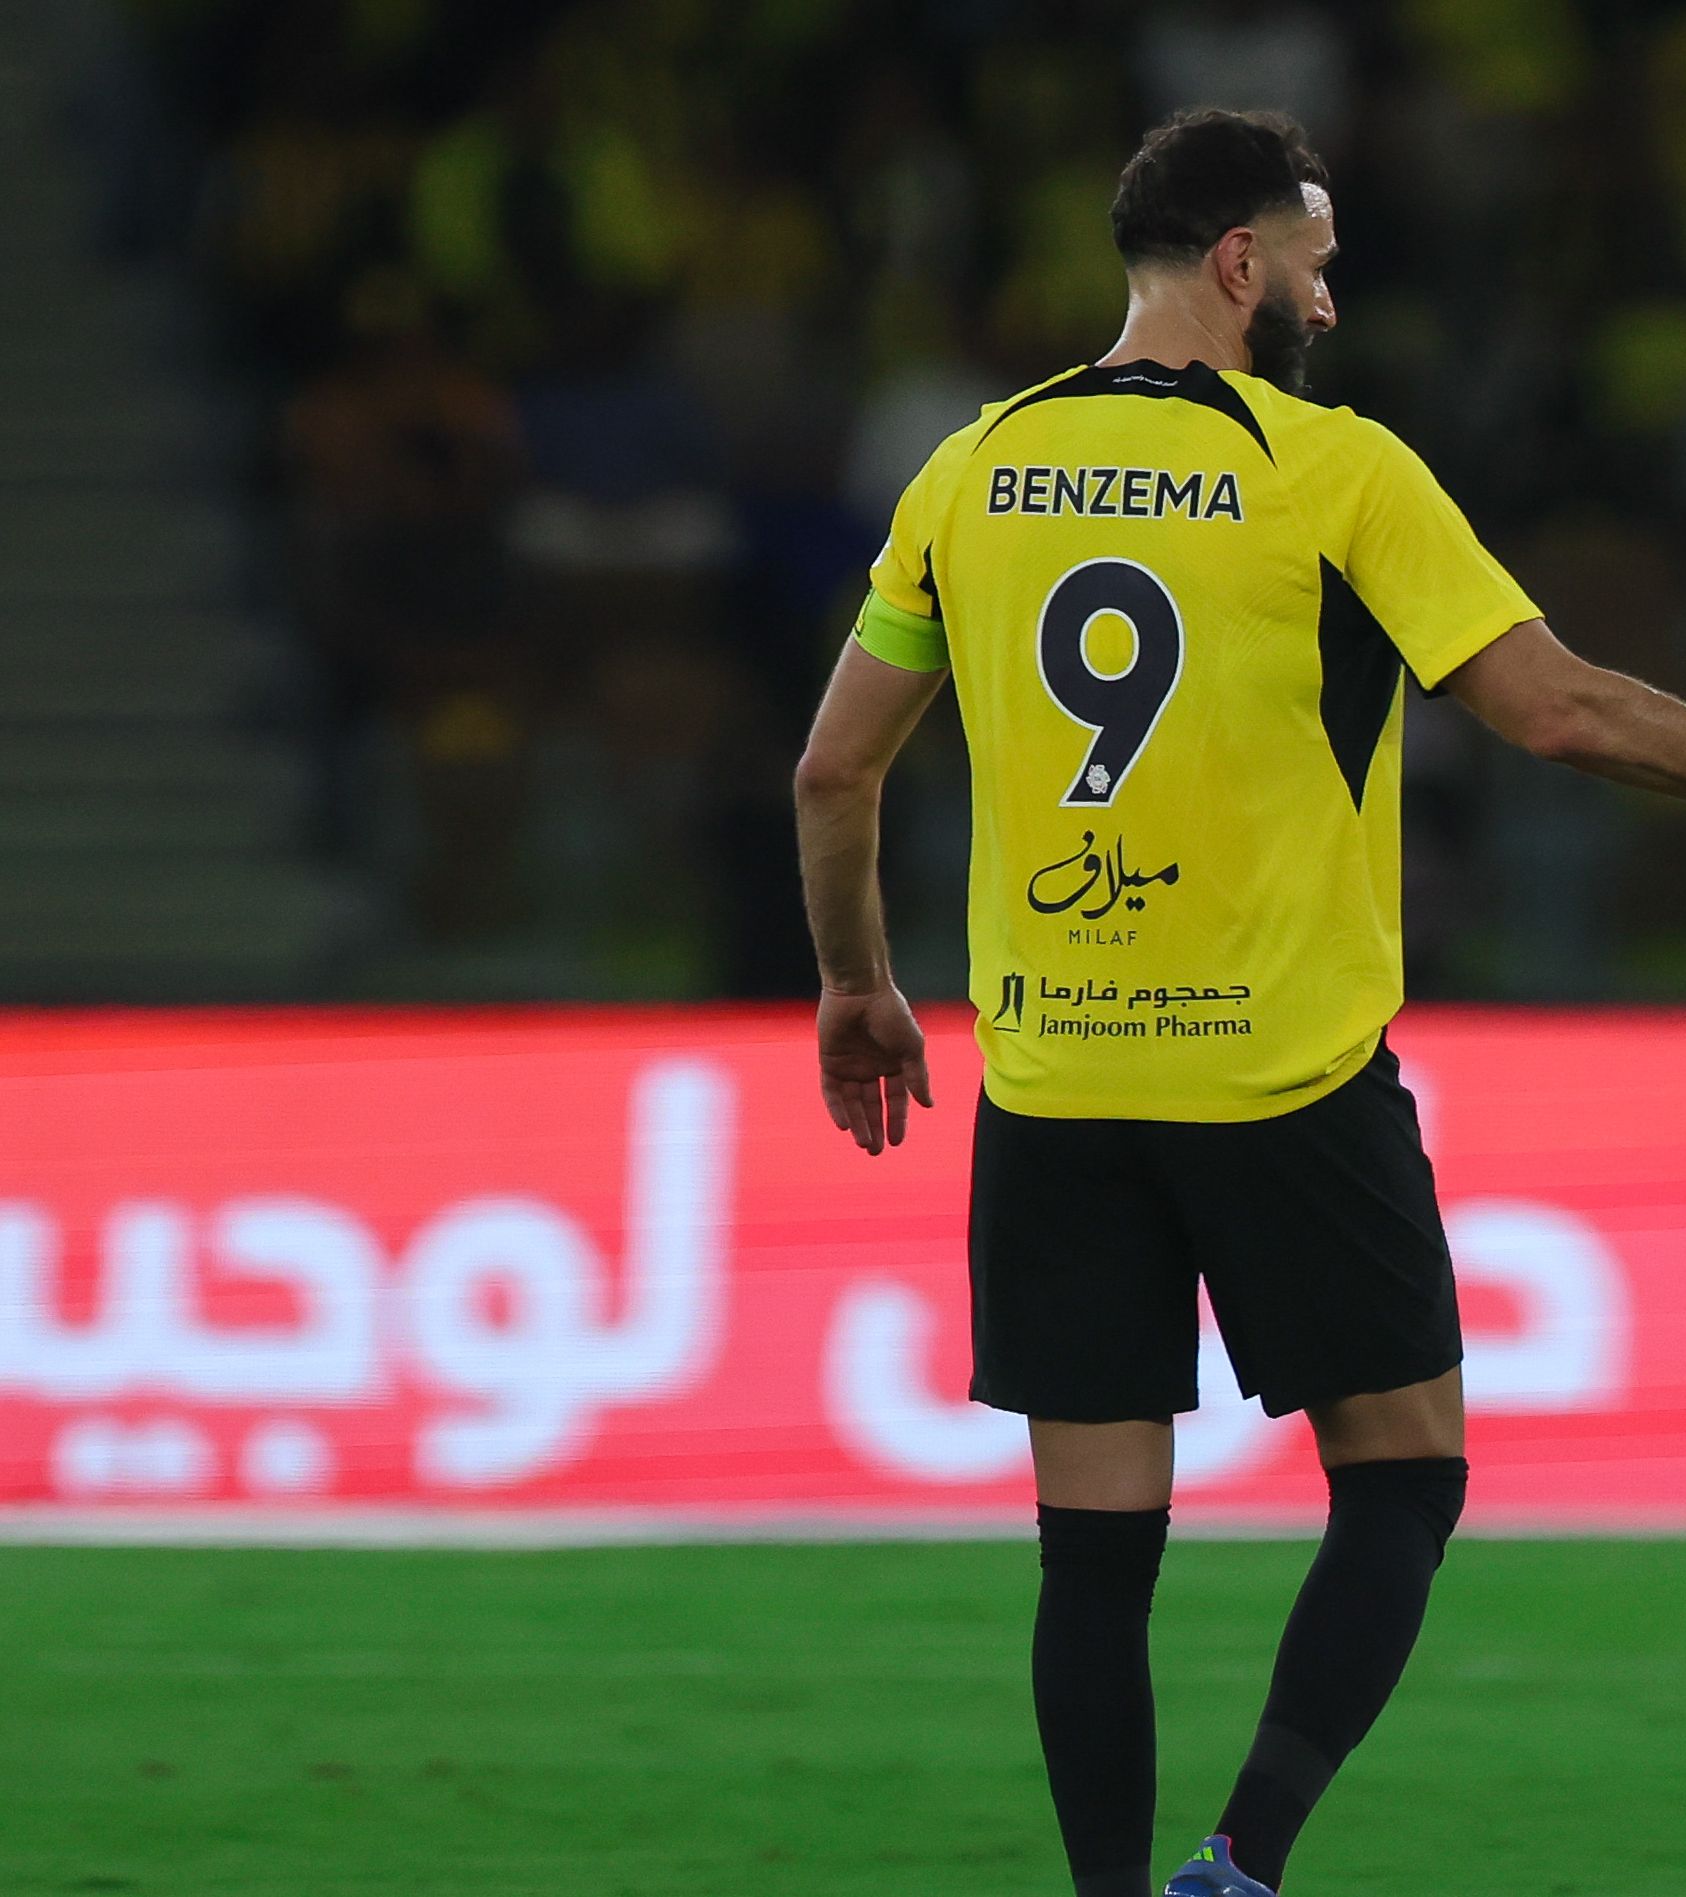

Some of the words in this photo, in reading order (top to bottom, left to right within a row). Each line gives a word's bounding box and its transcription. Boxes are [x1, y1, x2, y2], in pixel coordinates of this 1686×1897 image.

[987, 466, 1243, 522] BENZEMA
[1035, 556, 1185, 808] 9
[1027, 830, 1180, 920] ميلاف
[1068, 929, 1137, 945] MILAF
[1040, 976, 1118, 1007] فارما
[1127, 983, 1251, 1010] جمجوم
[1038, 1013, 1146, 1040] Jamjoom
[1155, 1014, 1252, 1037] Pharma
